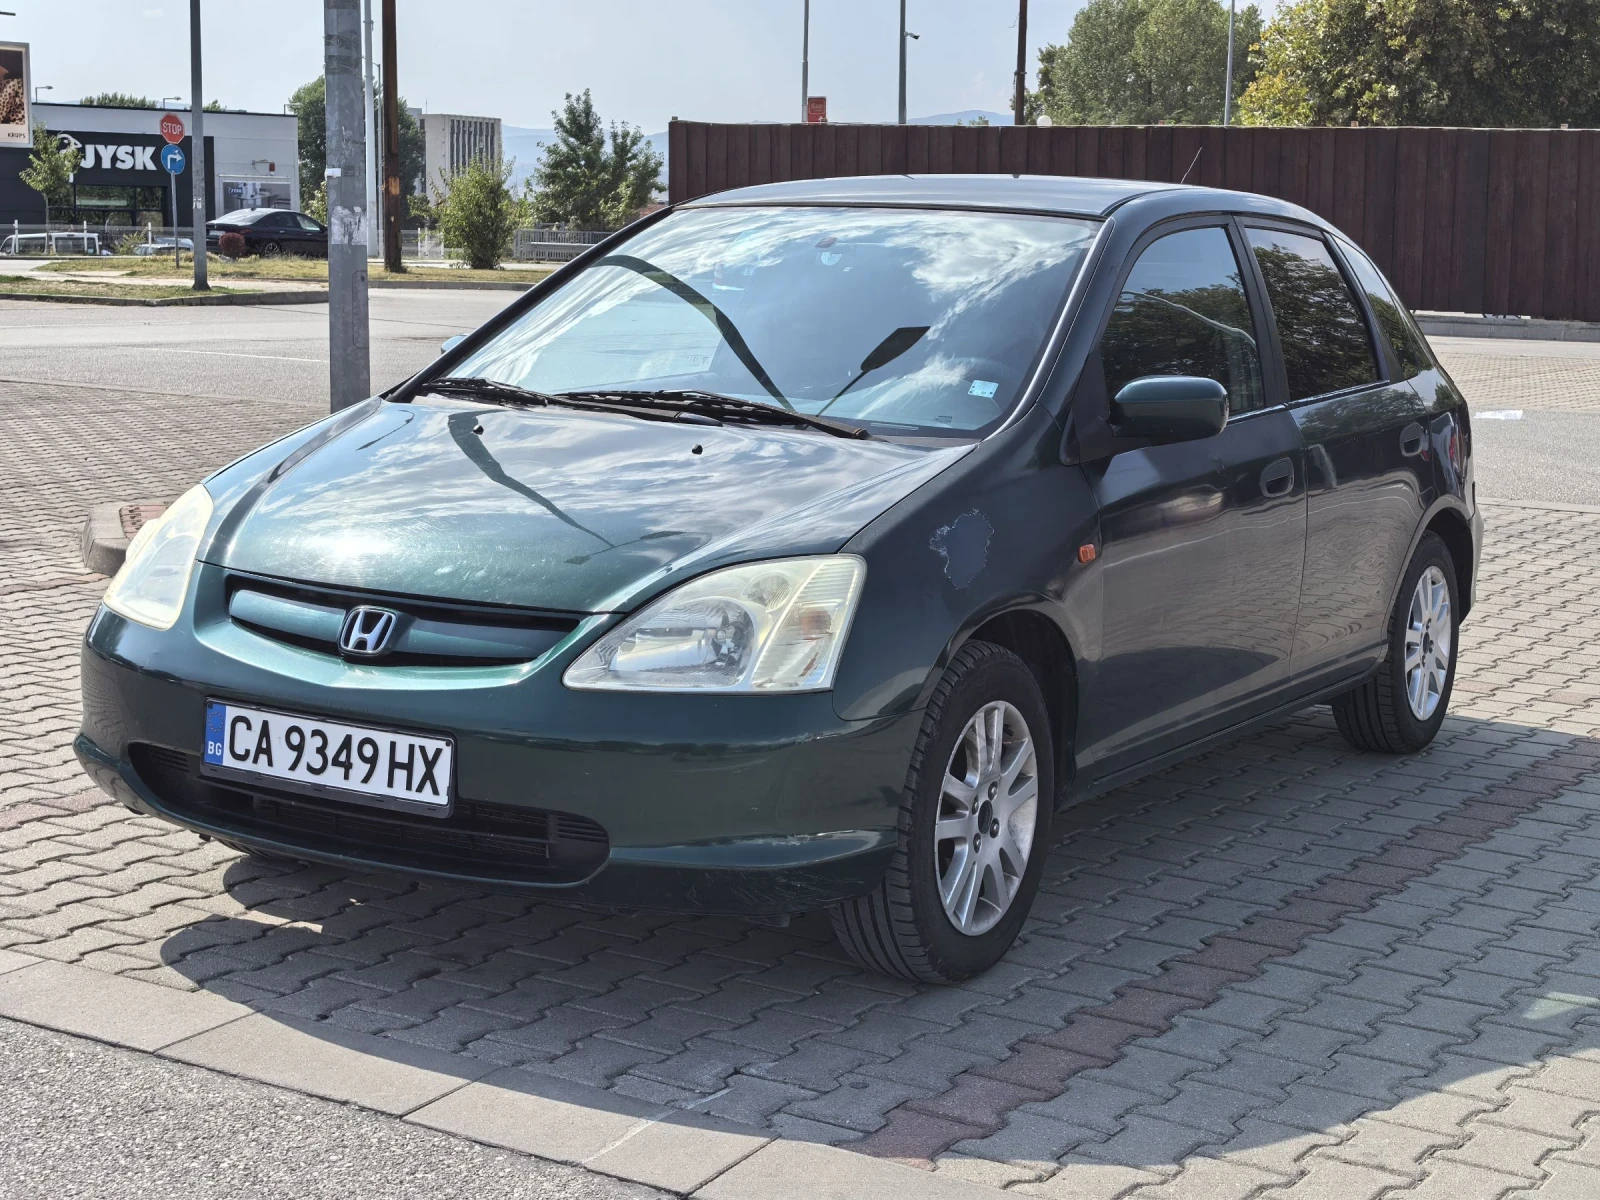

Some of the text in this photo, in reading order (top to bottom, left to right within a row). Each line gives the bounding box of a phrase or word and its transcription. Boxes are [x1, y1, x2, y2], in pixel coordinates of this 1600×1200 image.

[162, 121, 182, 135] STOP
[80, 144, 157, 171] JYSK
[207, 740, 223, 757] BG
[229, 715, 444, 796] CA 9349 HX
